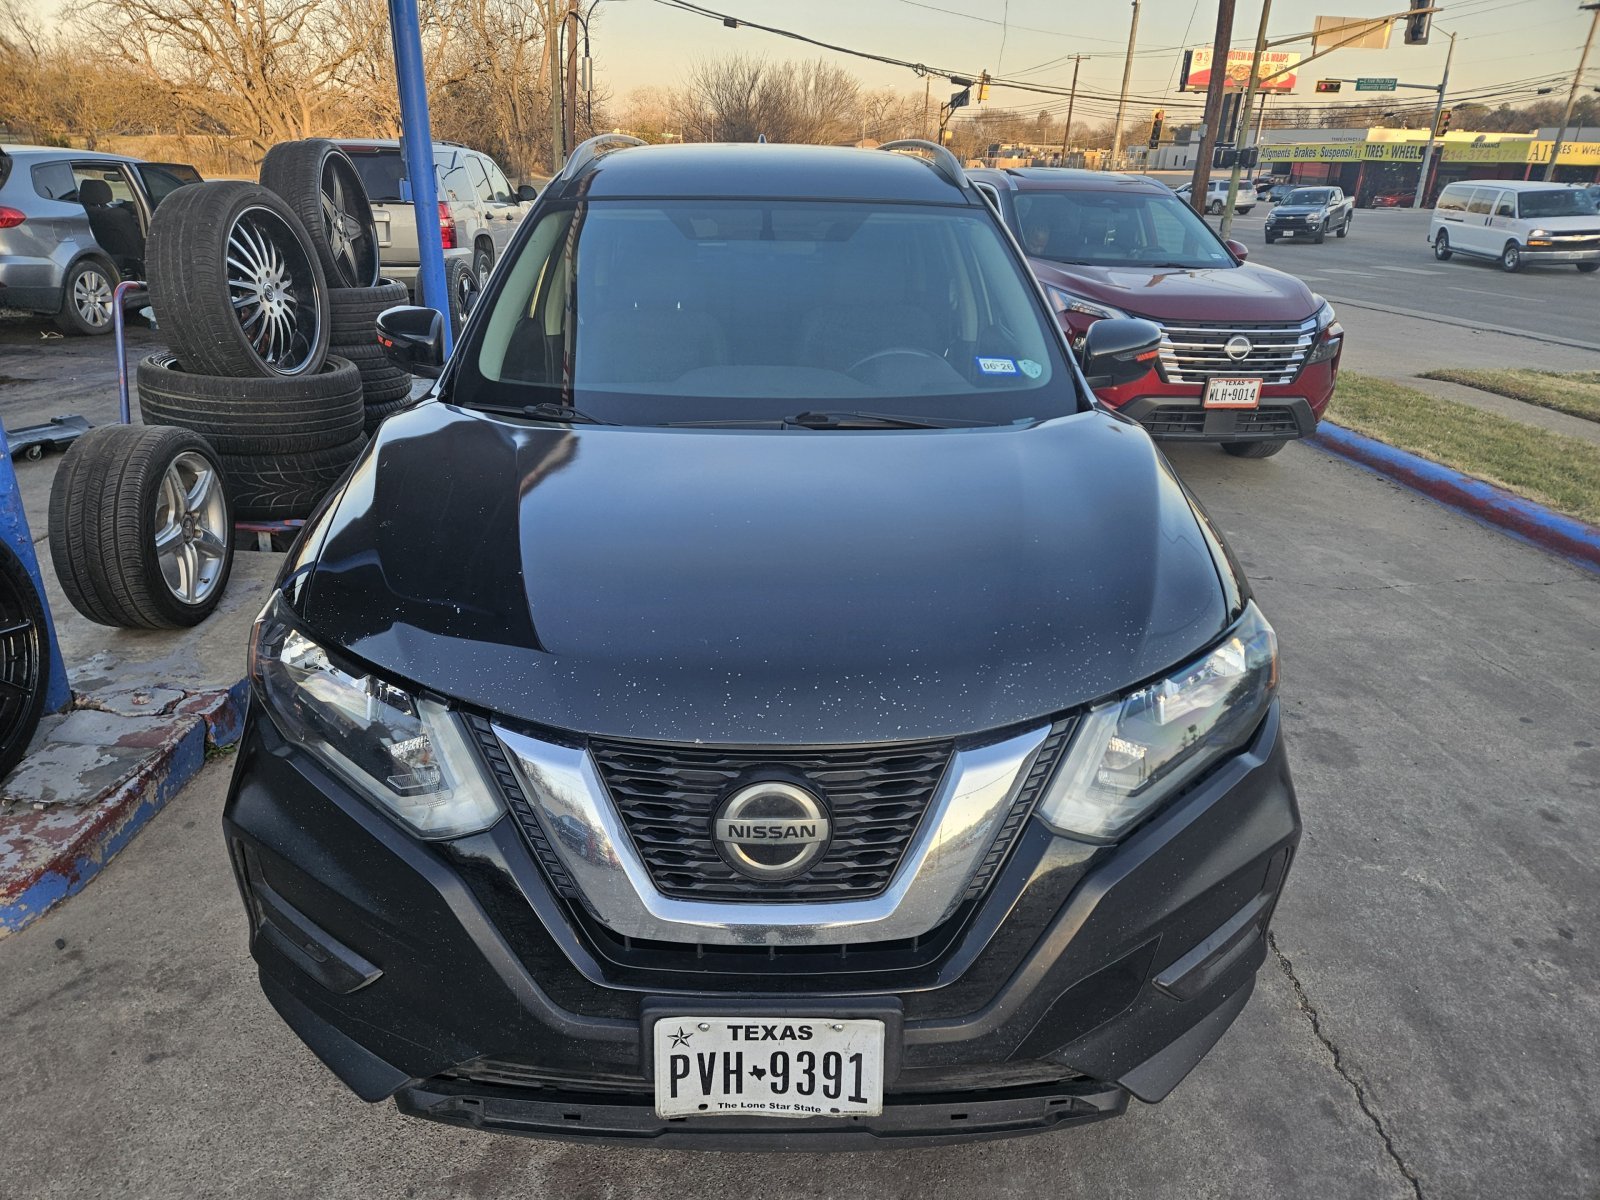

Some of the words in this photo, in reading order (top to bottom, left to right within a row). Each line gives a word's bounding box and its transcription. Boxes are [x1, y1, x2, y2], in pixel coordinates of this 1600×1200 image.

[1227, 50, 1247, 60] ROTEIN
[1247, 52, 1264, 61] BOS
[1271, 53, 1289, 62] WRAPS
[1293, 146, 1317, 158] Brakes
[1364, 145, 1384, 158] TIRES
[1391, 145, 1423, 159] WHEELS
[1528, 142, 1549, 161] A1
[728, 824, 816, 839] NISSAN
[727, 1025, 813, 1041] TEXAS
[670, 1051, 743, 1098] PVH
[769, 1050, 868, 1104] 9391
[769, 1102, 791, 1111] Star
[794, 1104, 822, 1114] State
